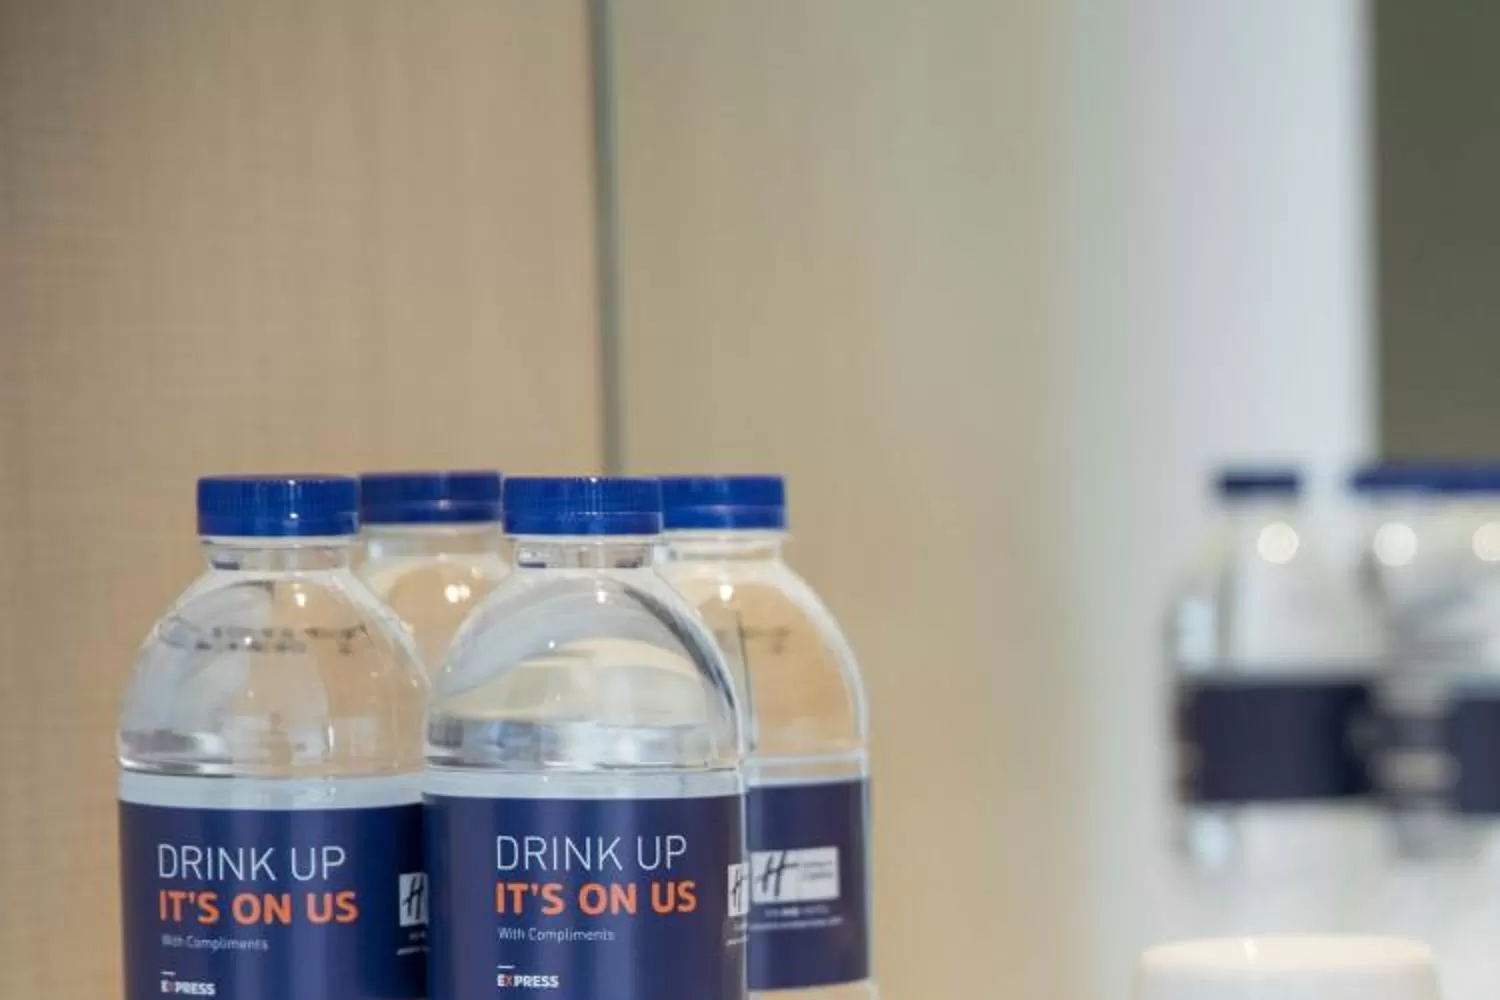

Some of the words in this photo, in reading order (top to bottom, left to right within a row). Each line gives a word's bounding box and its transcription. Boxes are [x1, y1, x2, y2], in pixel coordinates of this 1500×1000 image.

[158, 843, 277, 881] DRINK
[290, 845, 346, 882] UP
[496, 834, 623, 871] DRINK
[637, 834, 688, 871] UP
[159, 889, 220, 925] IT'S
[232, 892, 291, 925] ON
[306, 890, 360, 925] US
[495, 880, 563, 916] IT'S
[577, 881, 637, 916] ON
[651, 880, 698, 913] US
[498, 927, 525, 941] With
[527, 927, 616, 943] Compliments
[496, 973, 560, 988] EXPRESS
